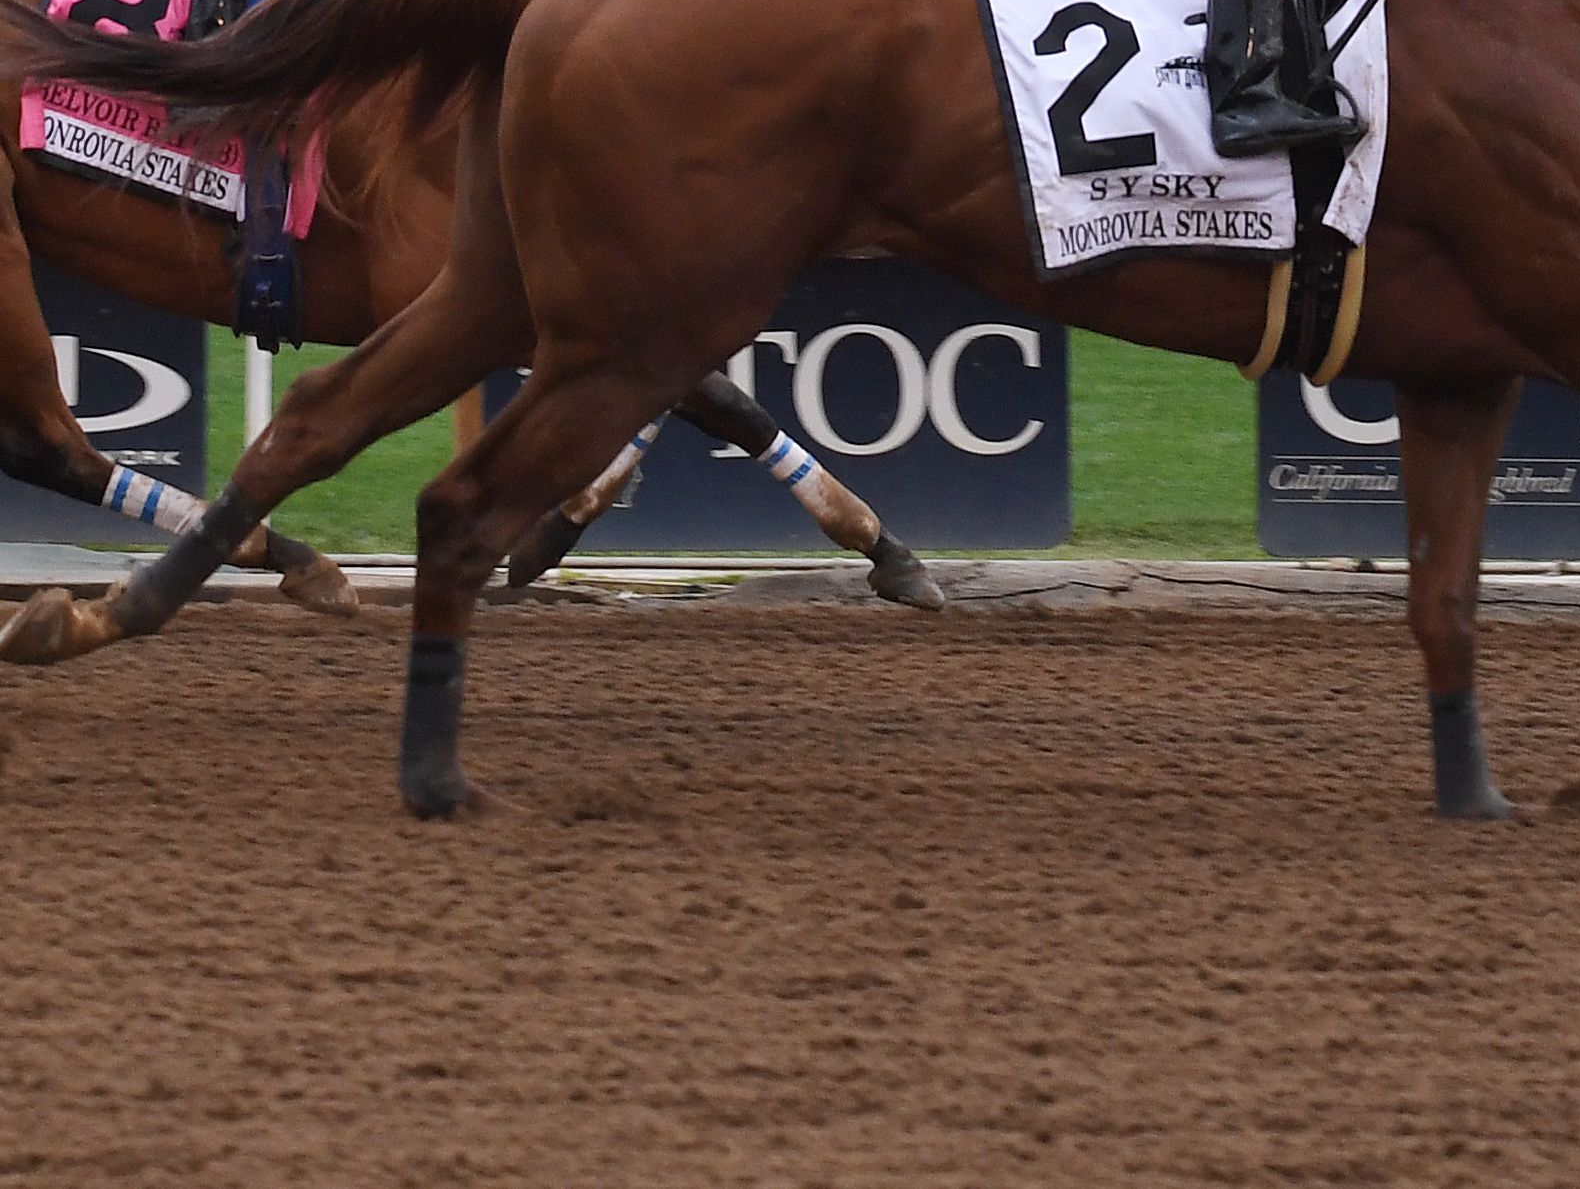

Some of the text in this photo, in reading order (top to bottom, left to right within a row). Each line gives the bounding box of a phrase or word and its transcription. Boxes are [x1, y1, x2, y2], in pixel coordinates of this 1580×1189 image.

[1033, 2, 1158, 176] 2
[1058, 210, 1273, 257] MONROVIA STAKES
